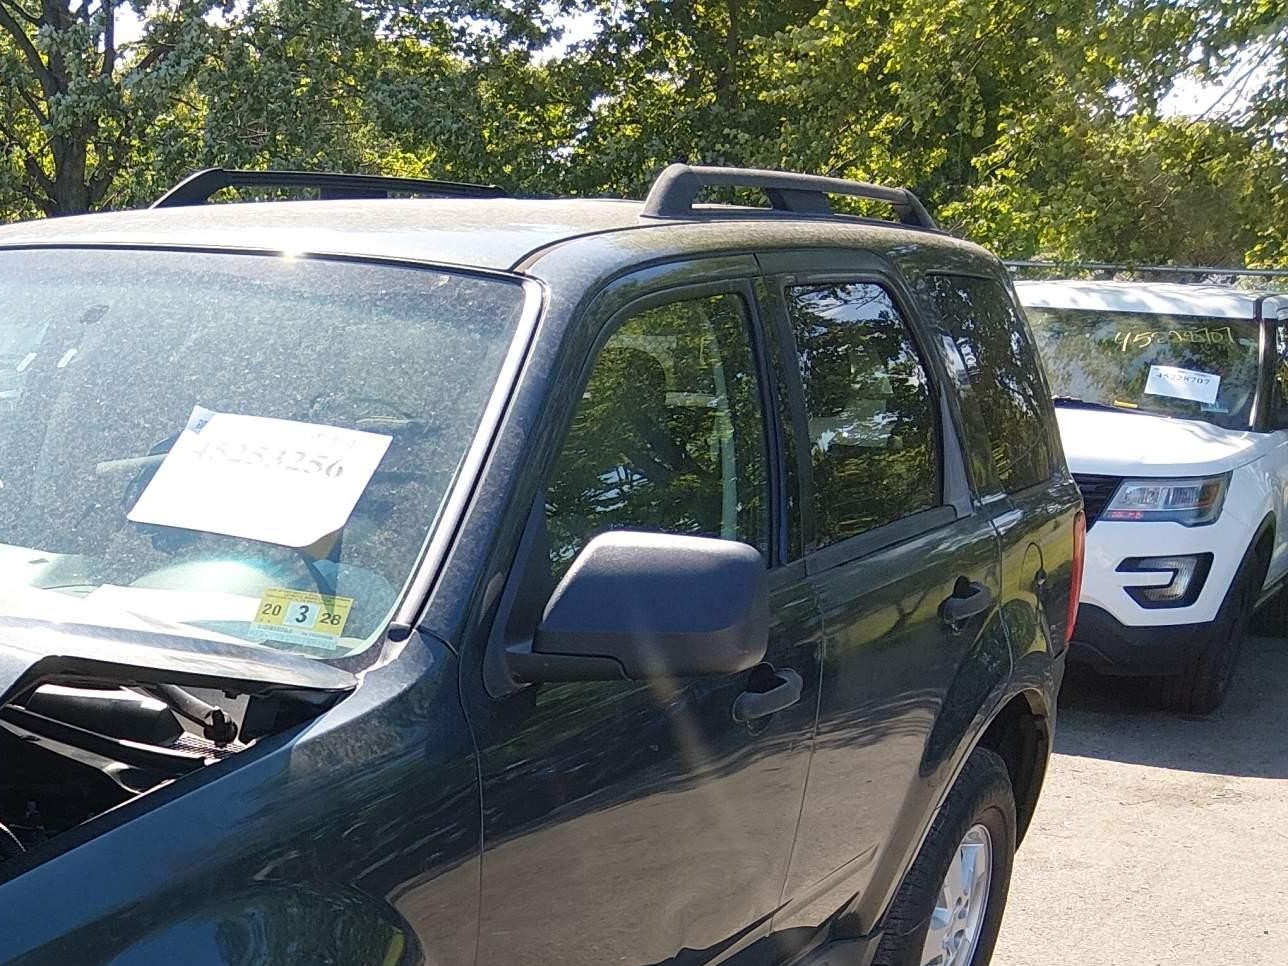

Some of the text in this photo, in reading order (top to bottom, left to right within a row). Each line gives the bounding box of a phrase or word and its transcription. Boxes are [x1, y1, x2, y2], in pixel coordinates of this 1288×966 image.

[193, 439, 344, 478] 45253256
[261, 602, 342, 626] 20 3 28
